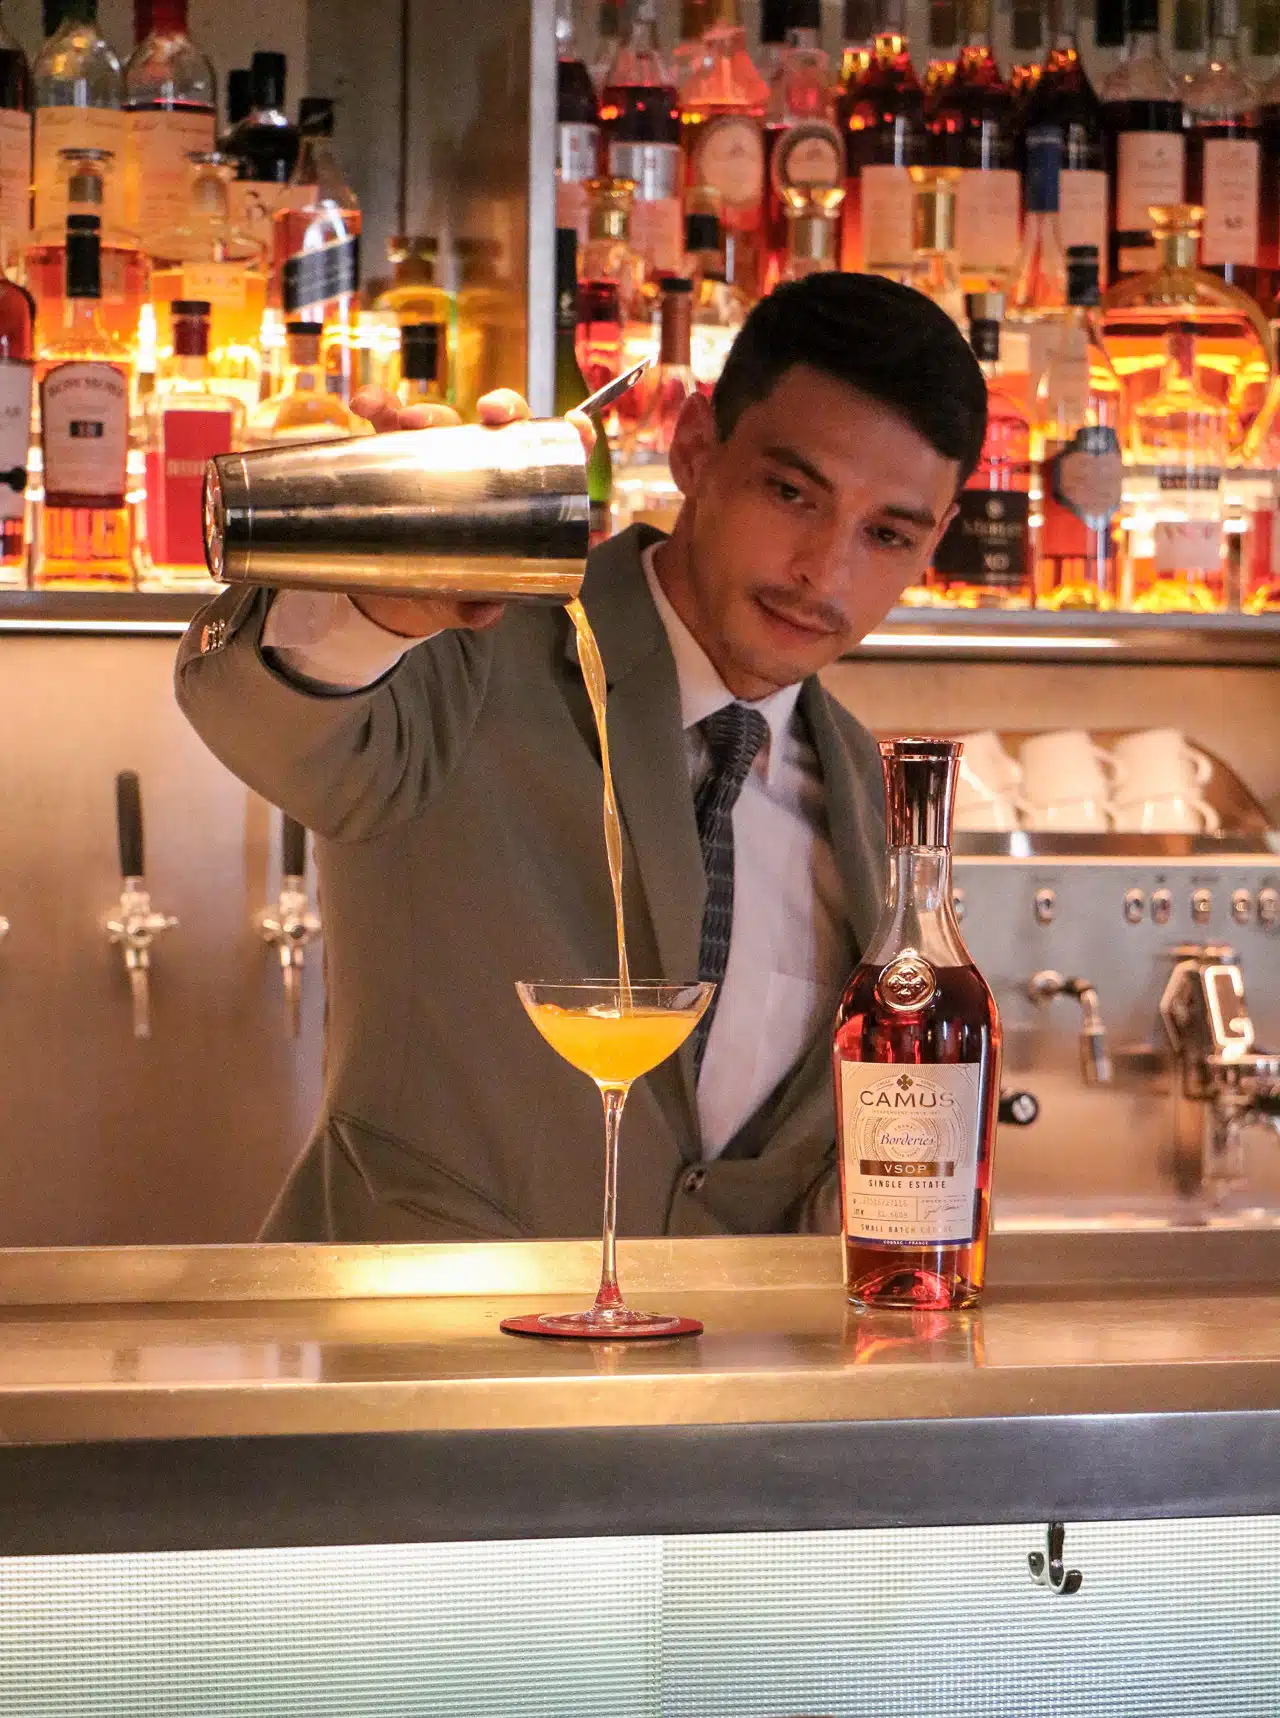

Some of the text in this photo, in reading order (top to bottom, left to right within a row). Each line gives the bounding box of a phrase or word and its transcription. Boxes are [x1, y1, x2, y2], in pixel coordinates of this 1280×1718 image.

[860, 1090, 955, 1108] CAMUS
[880, 1132, 935, 1146] Borderies
[884, 1164, 926, 1174] VSOP
[868, 1179, 946, 1189] SINGLE ESTATE
[860, 1223, 884, 1232] SMALL
[889, 1226, 916, 1234] BATCH
